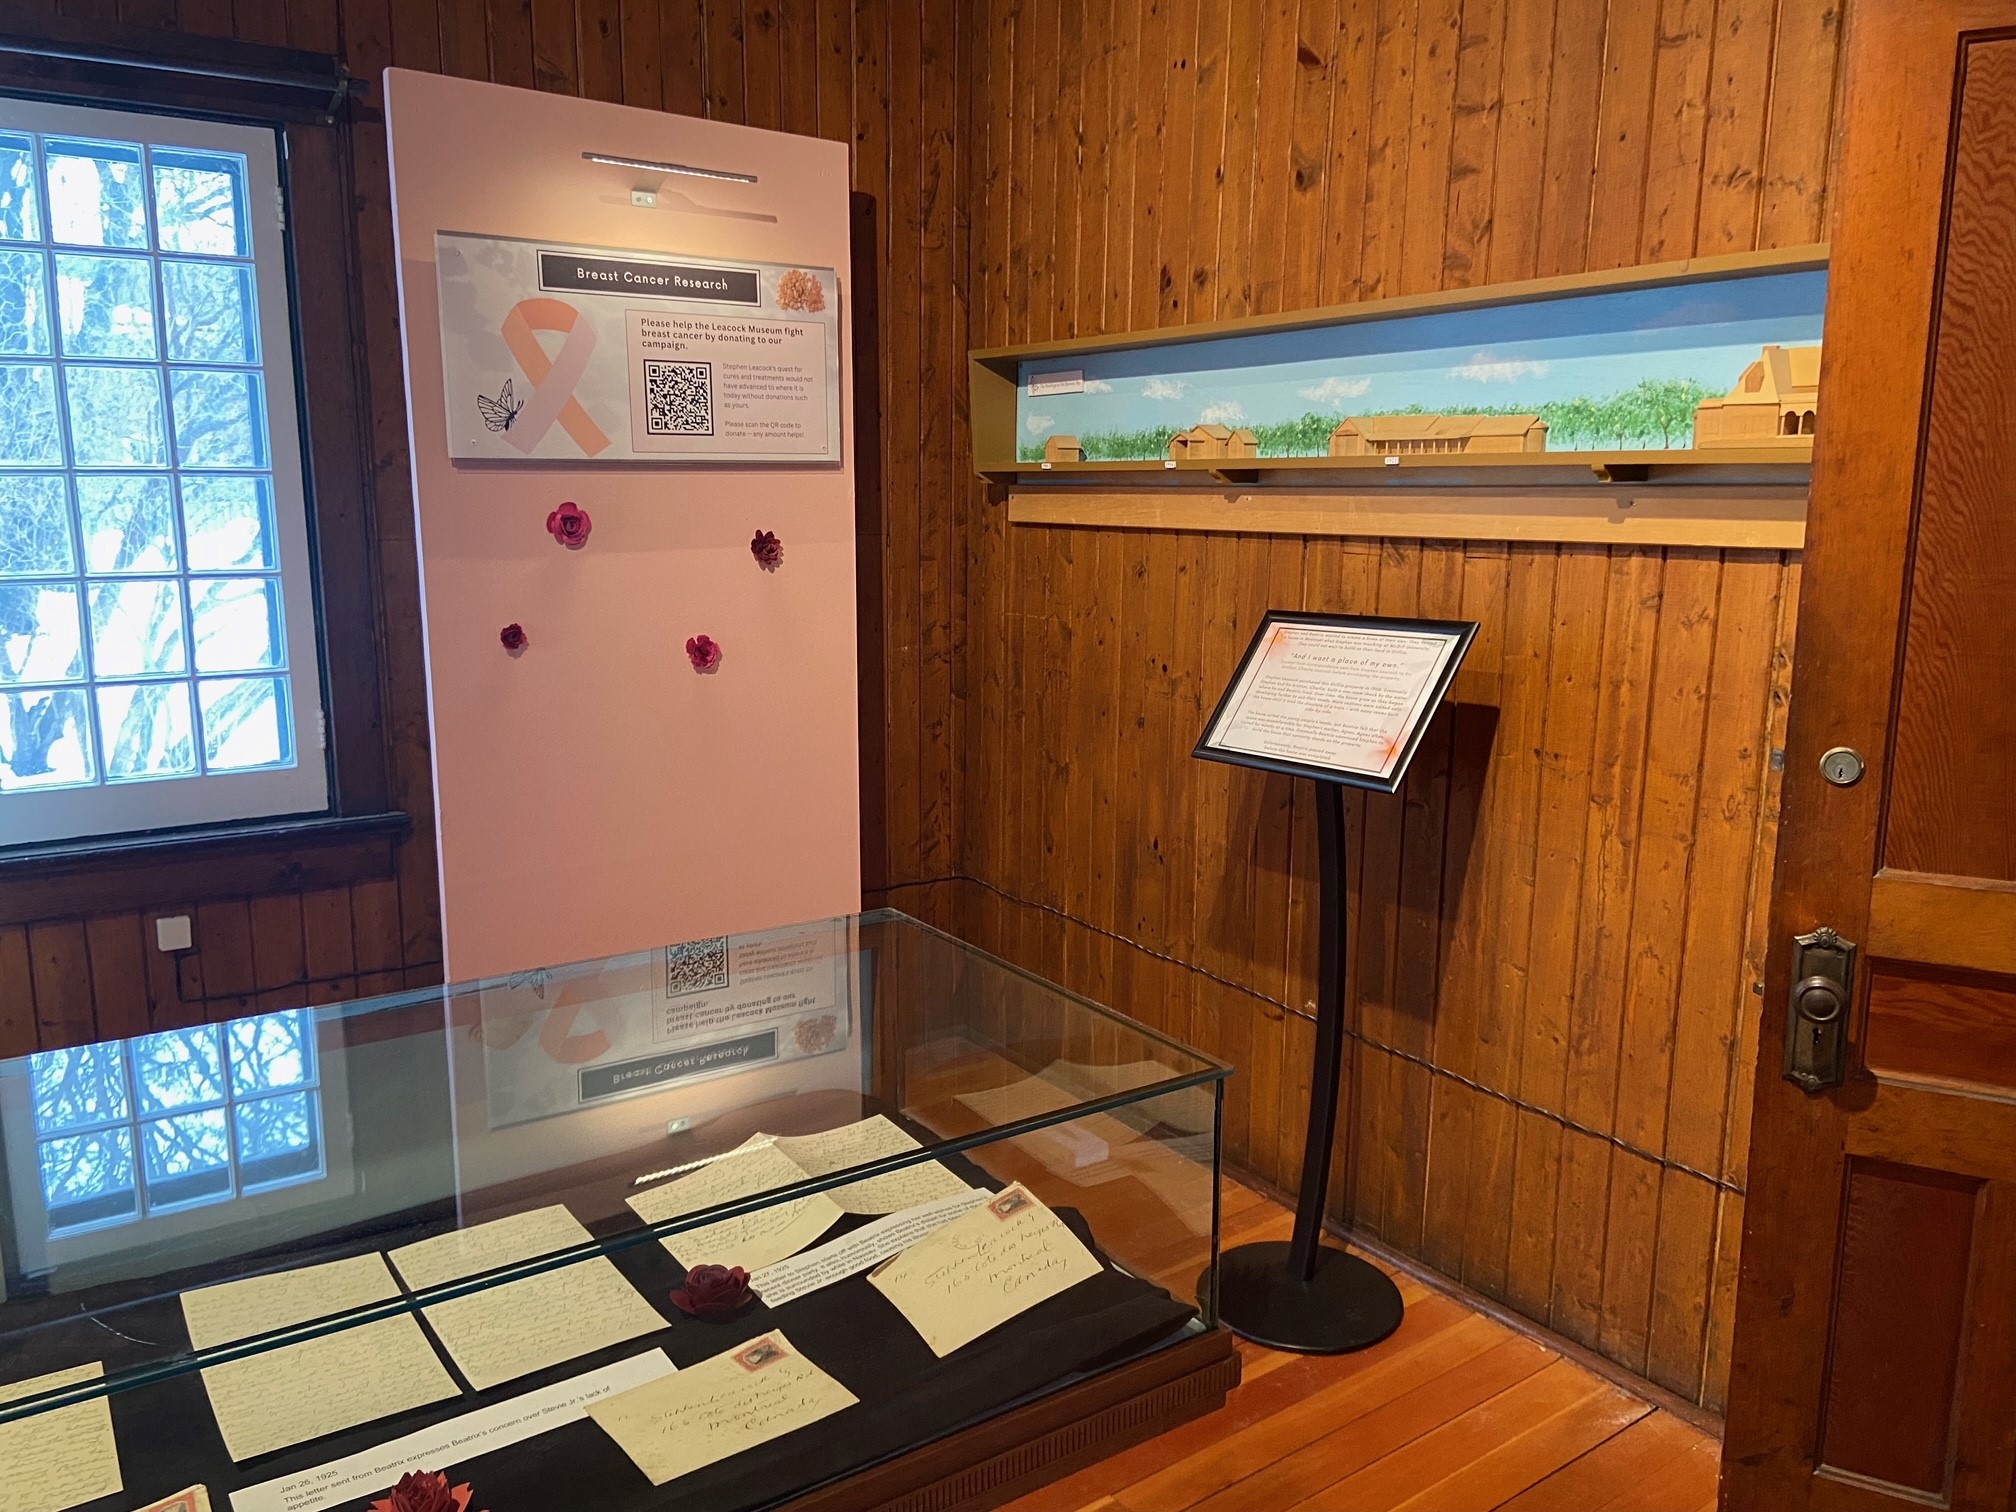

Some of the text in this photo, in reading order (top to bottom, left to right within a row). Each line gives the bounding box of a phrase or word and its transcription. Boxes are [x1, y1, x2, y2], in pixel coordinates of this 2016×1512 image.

[576, 268, 729, 290] Breast Cancer Research
[641, 319, 804, 337] Please help the Leacock Museum fight
[642, 329, 670, 338] breast
[705, 333, 715, 343] by
[718, 334, 755, 345] donating
[642, 341, 688, 351] campaign.
[723, 363, 747, 371] Stephen
[724, 392, 740, 400] today
[756, 1281, 770, 1289] This
[795, 1261, 820, 1273] Stephen
[847, 1241, 860, 1251] with
[860, 1232, 880, 1244] Beatrix
[284, 1494, 304, 1504] This
[306, 1486, 329, 1497] letter
[331, 1477, 351, 1488] sent
[352, 1471, 373, 1482] from
[374, 1459, 406, 1474] Beatrix
[407, 1443, 450, 1462] expresses
[452, 1430, 488, 1446] Beatrix's
[489, 1418, 522, 1433] concern
[523, 1412, 541, 1422] over
[541, 1402, 567, 1415] Stevie
[585, 1388, 602, 1399] lack
[603, 1385, 611, 1393] of
[279, 1470, 338, 1493] Jan 26, 1925
[287, 1496, 326, 1511] appetite.
